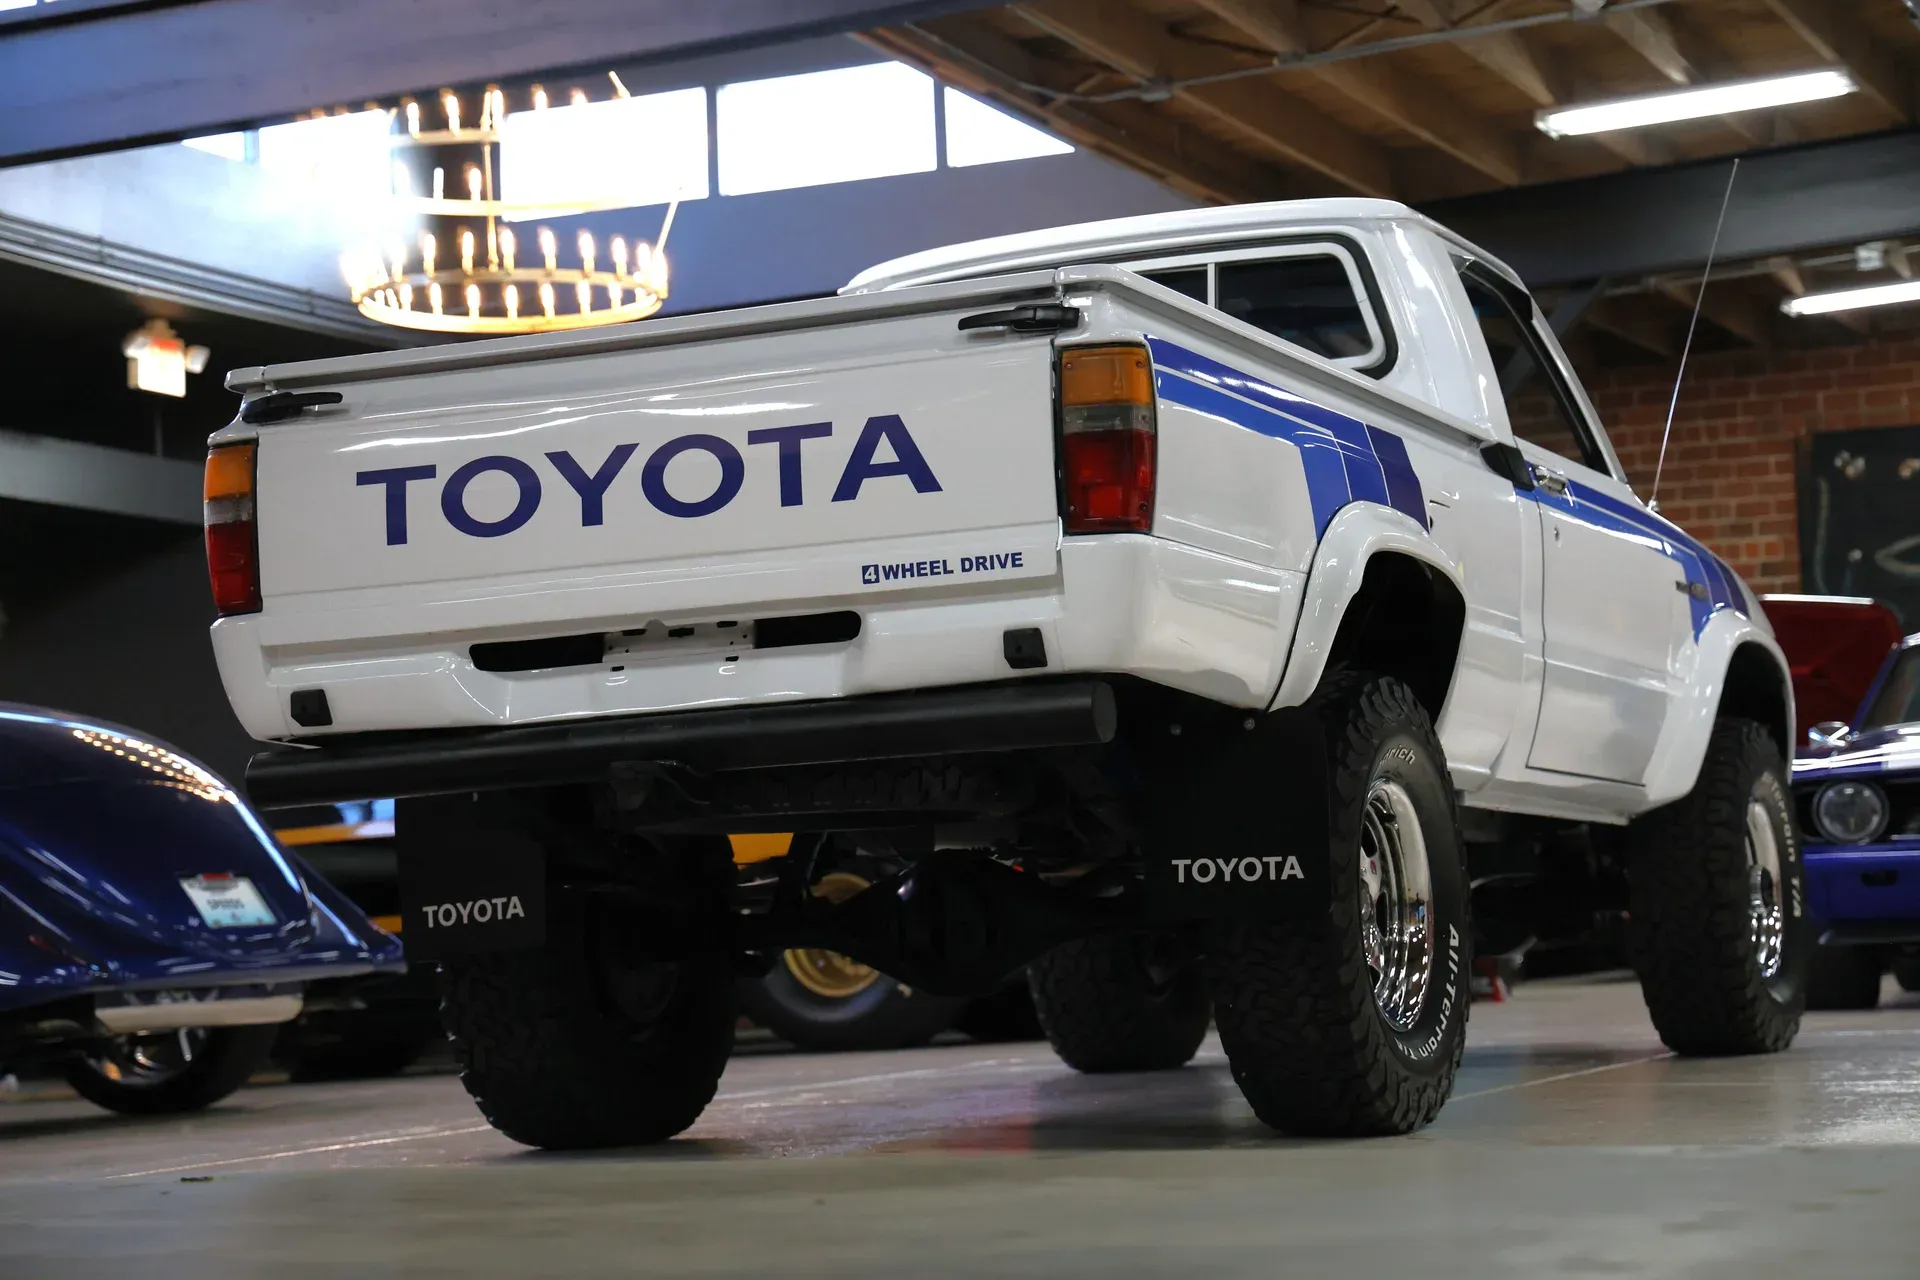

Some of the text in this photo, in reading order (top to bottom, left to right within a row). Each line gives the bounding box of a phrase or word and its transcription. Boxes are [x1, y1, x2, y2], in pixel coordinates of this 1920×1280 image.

[356, 414, 943, 546] TOYOTA
[960, 552, 1023, 572] DRIVE
[1171, 855, 1305, 883] TOYOTA
[422, 896, 525, 928] TOYOTA
[1419, 923, 1460, 1057] All-Terrain
